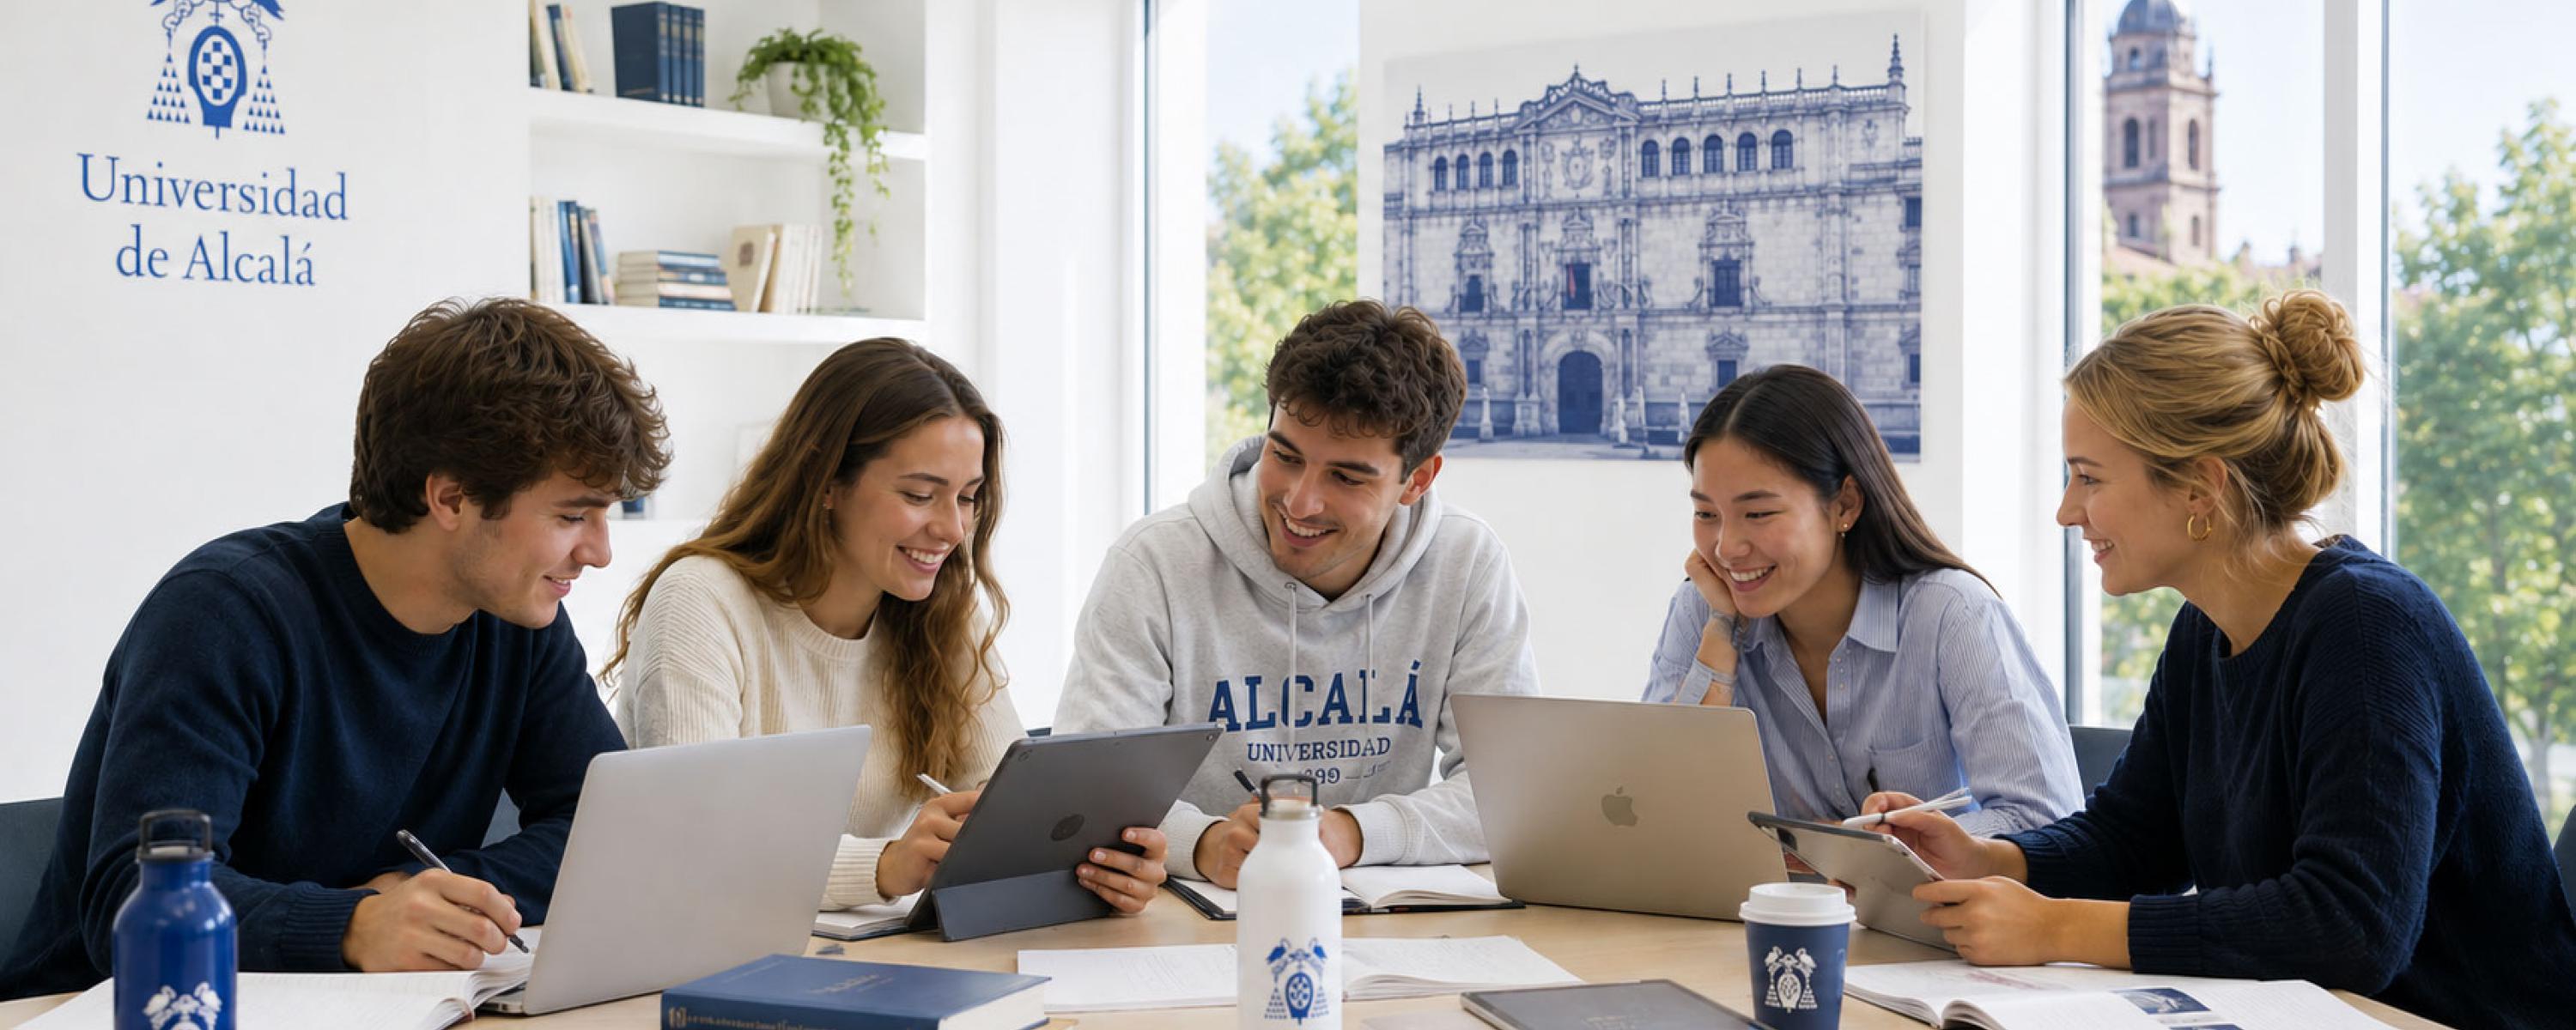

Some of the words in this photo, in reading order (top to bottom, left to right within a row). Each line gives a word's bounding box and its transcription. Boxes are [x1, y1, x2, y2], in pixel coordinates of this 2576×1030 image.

[77, 153, 348, 221] Universidad
[116, 223, 169, 279] de
[182, 230, 315, 288] Alcalá
[1209, 659, 1423, 733] ALCALÁ
[1247, 736, 1391, 762] UNIVERSIDAD
